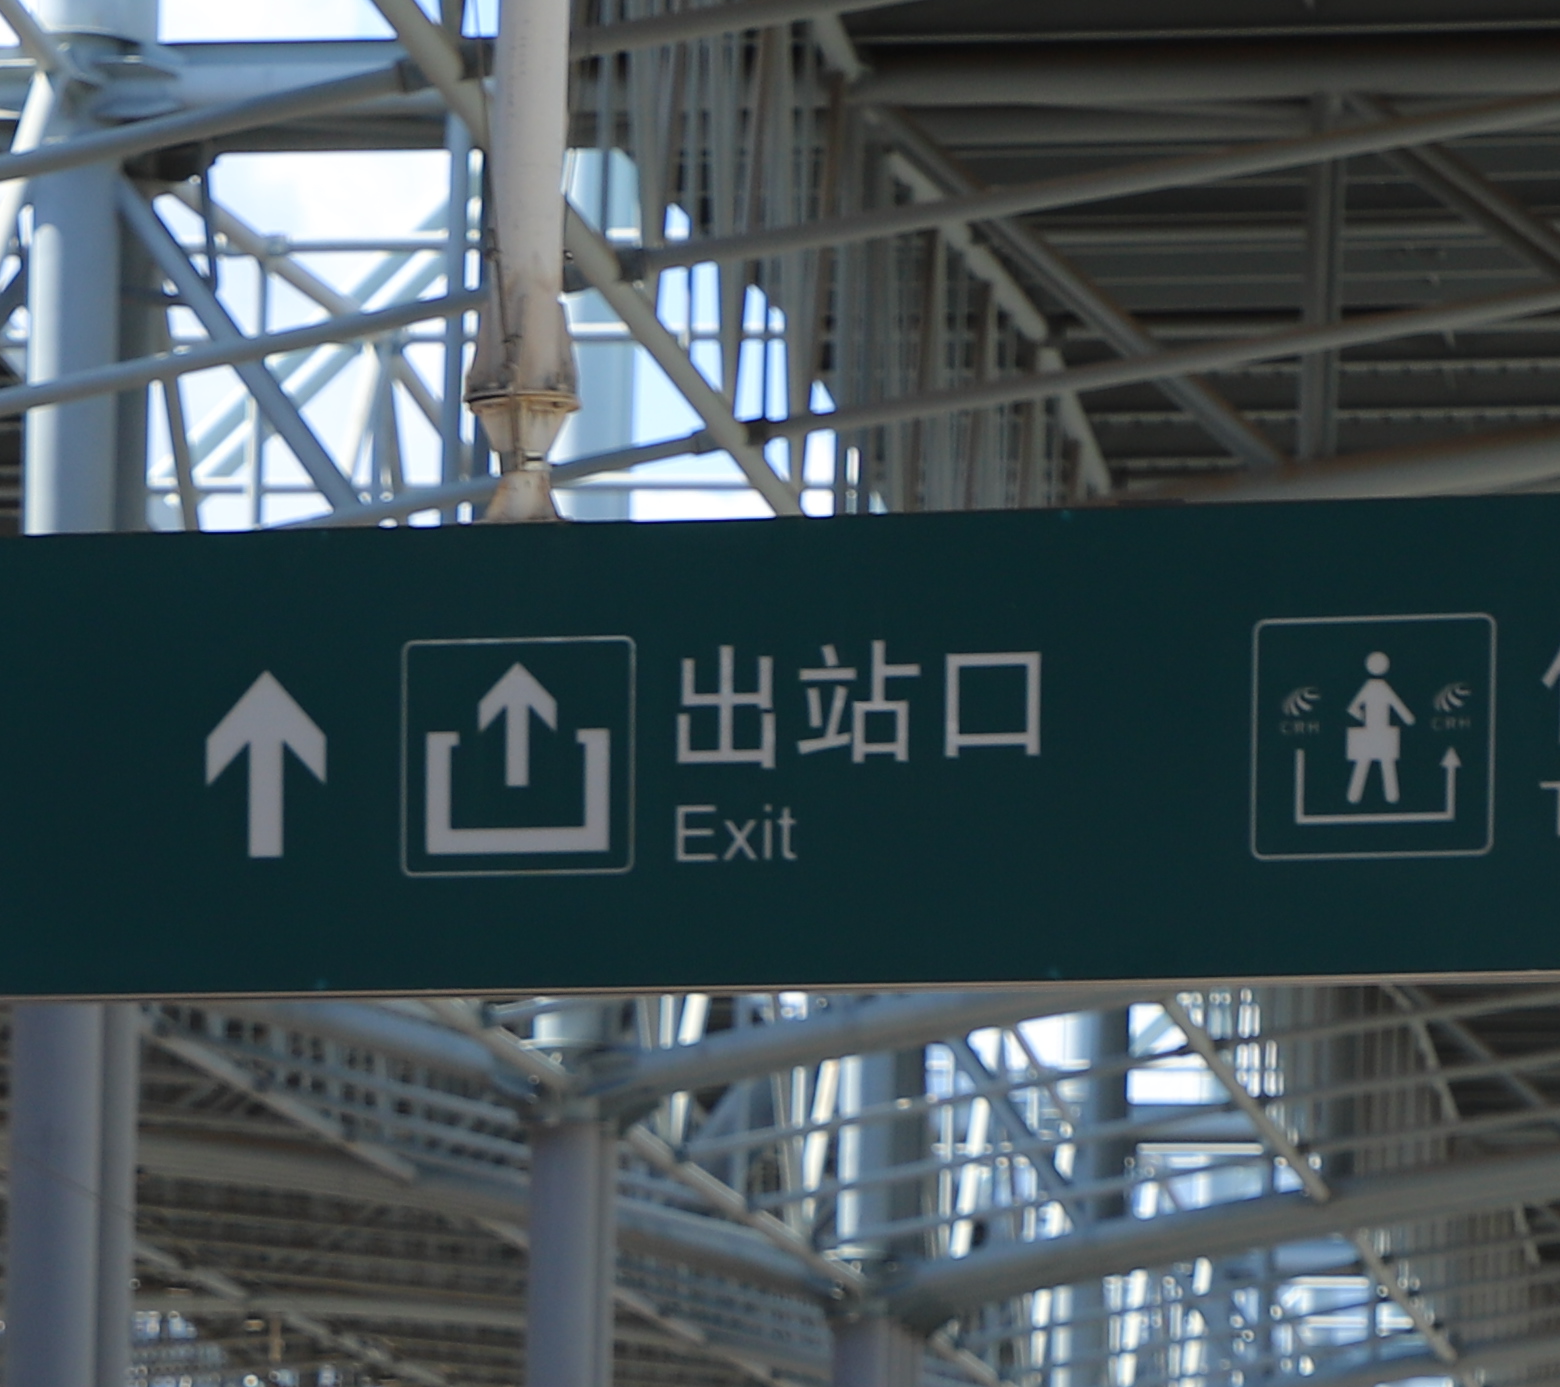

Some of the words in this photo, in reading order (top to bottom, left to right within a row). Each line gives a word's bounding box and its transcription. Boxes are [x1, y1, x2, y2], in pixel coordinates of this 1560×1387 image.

[676, 639, 1043, 769] 出站口
[1278, 720, 1321, 735] CRH
[1430, 716, 1472, 731] CRH
[675, 804, 798, 863] Exit
